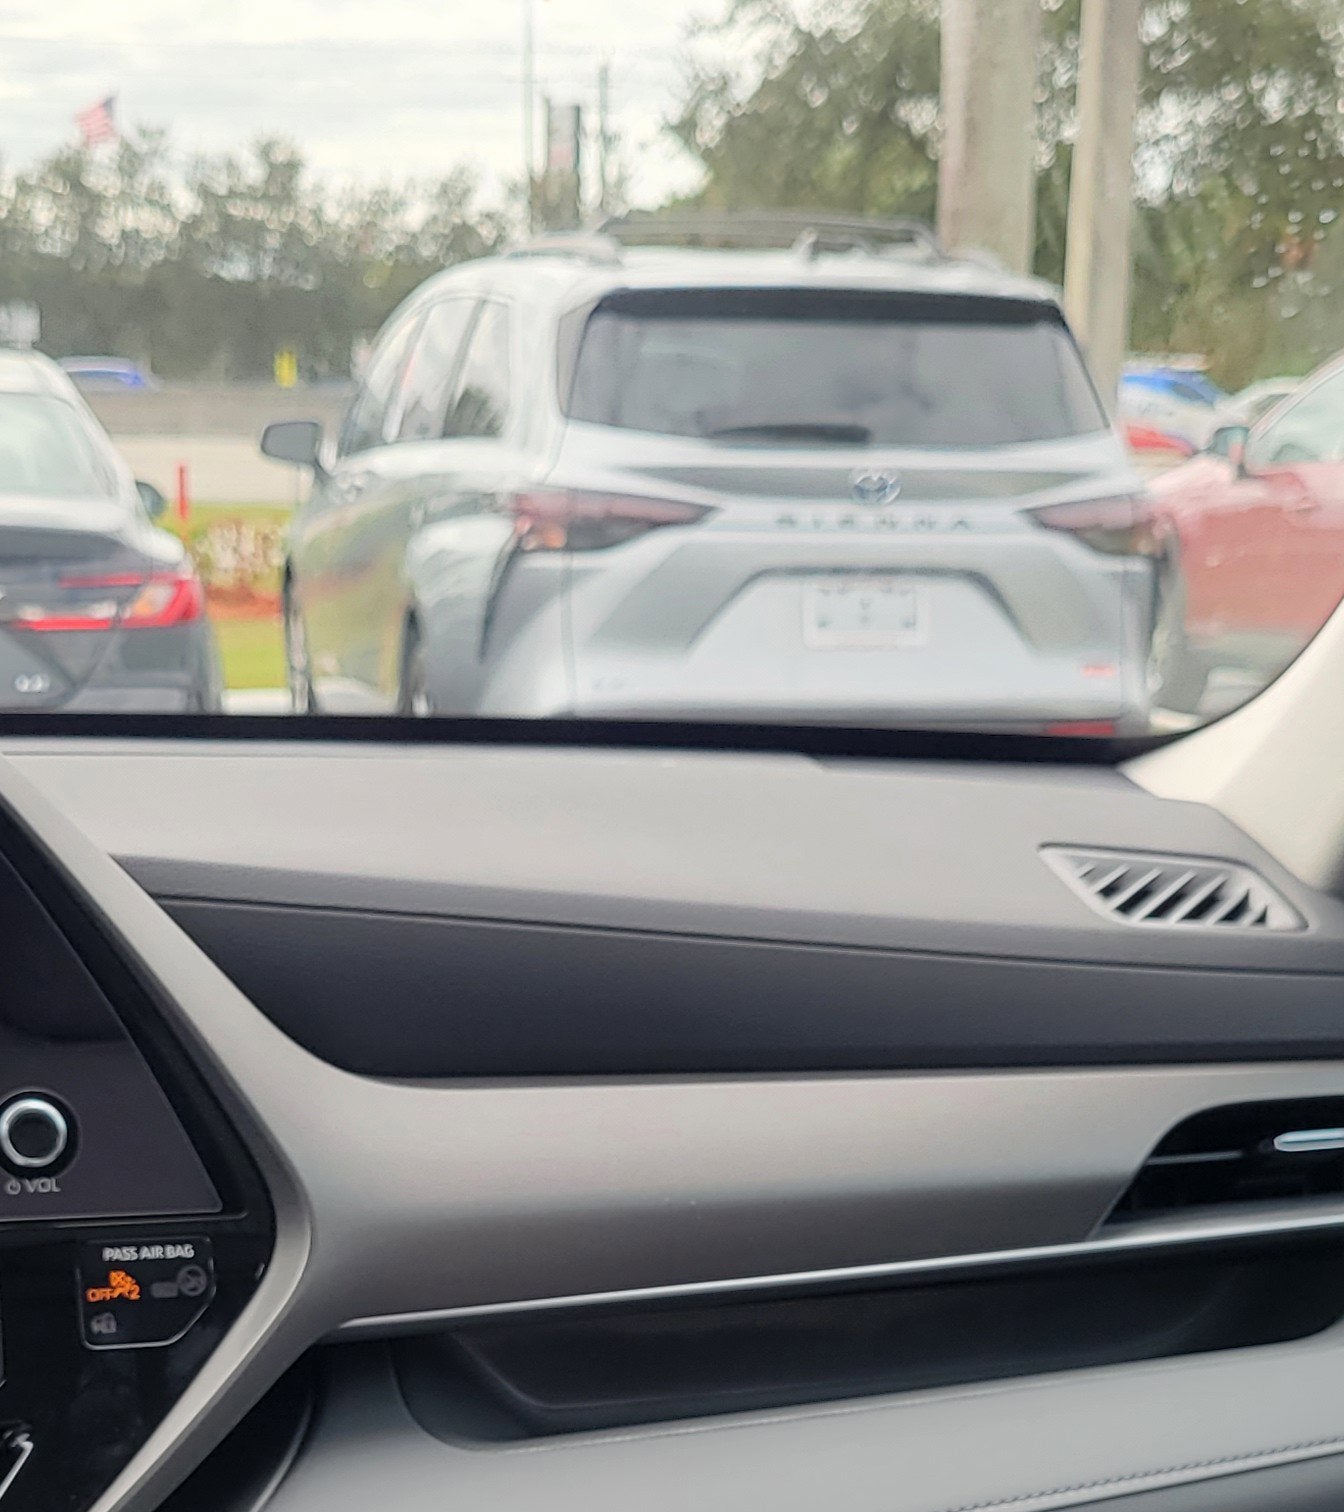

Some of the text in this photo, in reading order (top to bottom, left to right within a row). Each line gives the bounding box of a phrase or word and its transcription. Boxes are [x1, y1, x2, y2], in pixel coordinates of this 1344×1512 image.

[25, 1177, 61, 1193] VOL
[102, 1243, 195, 1261] PASS AIR BAG
